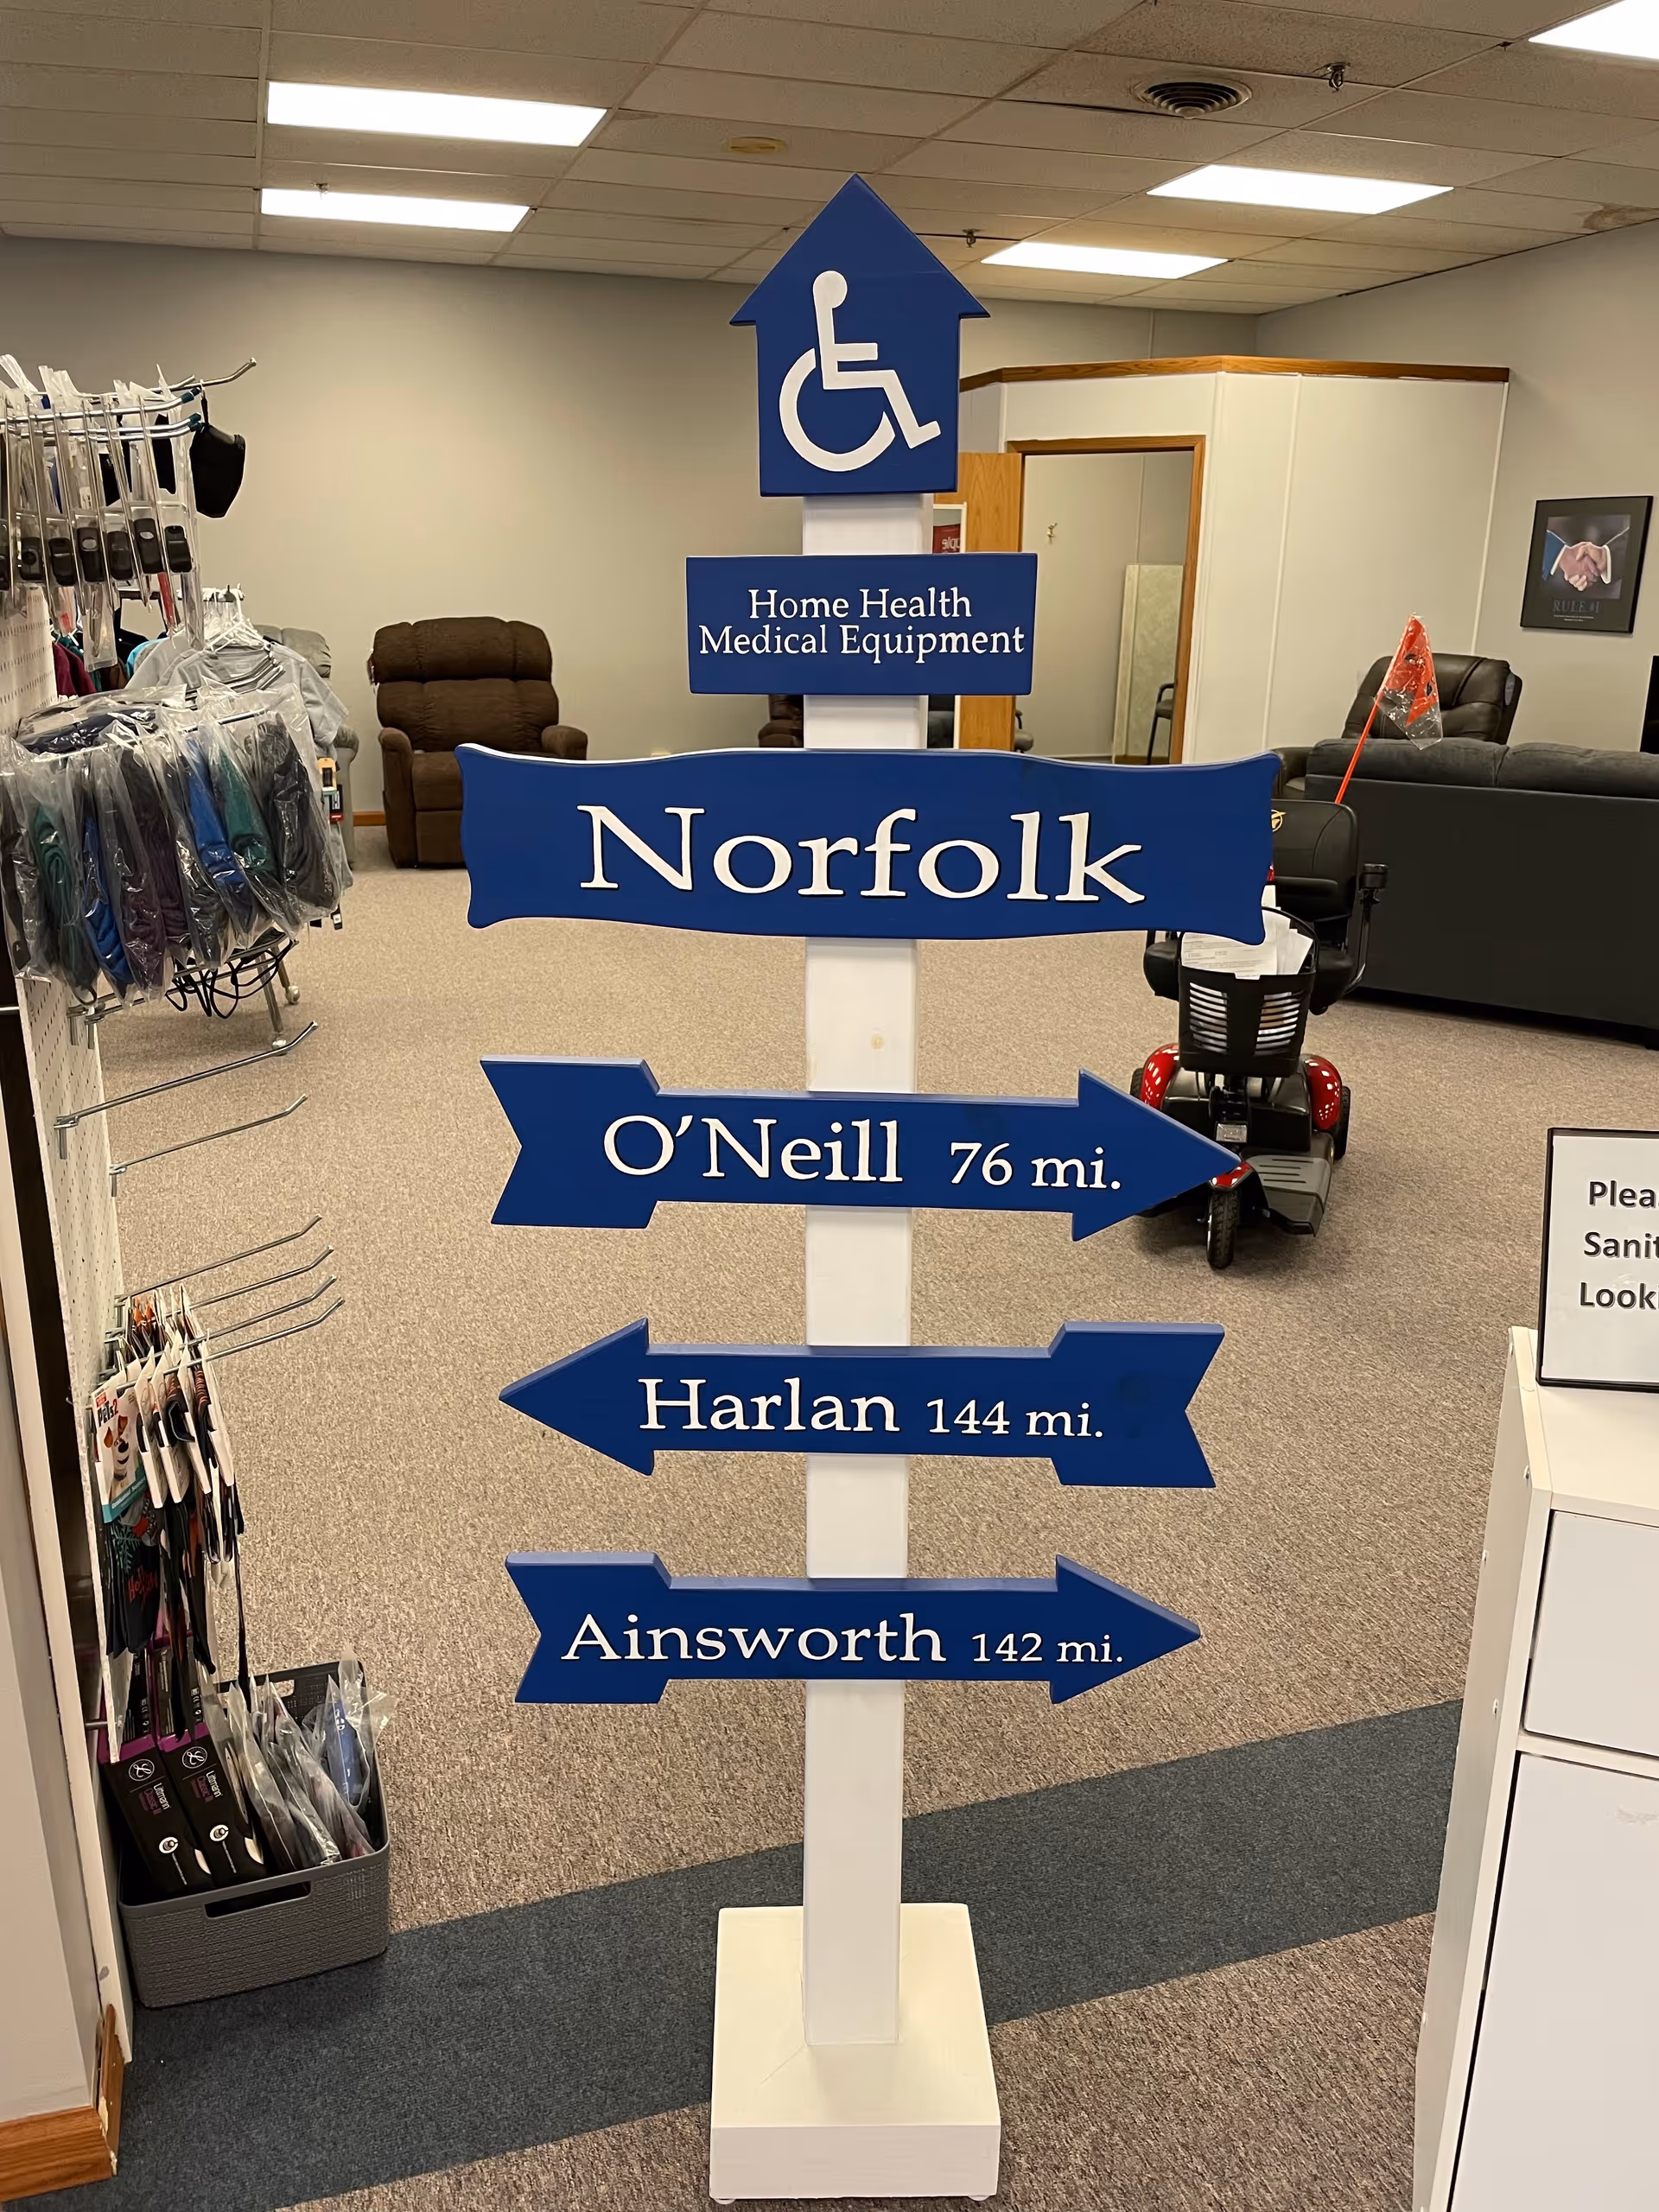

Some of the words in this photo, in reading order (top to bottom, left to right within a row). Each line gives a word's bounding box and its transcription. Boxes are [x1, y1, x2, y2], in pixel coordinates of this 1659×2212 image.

[747, 588, 849, 620] Home
[859, 587, 972, 619] Health
[698, 625, 828, 655] Medical
[839, 624, 1026, 664] Equipment
[576, 804, 1145, 904] Norfolk
[603, 1115, 903, 1183] O'Neill
[950, 1141, 1014, 1186] 76
[1031, 1147, 1122, 1191] mi.
[1588, 1180, 1659, 1208] Plea
[1580, 1281, 1659, 1310] Look
[638, 1376, 900, 1433] Harlan
[926, 1398, 1010, 1435] 144
[1025, 1402, 1104, 1439] mi.
[560, 1612, 947, 1662] Ainsworth
[971, 1633, 1043, 1662] 142
[1056, 1634, 1123, 1663] mi.
[153, 1783, 171, 1810] Littmann
[206, 1770, 224, 1798] Littmann
